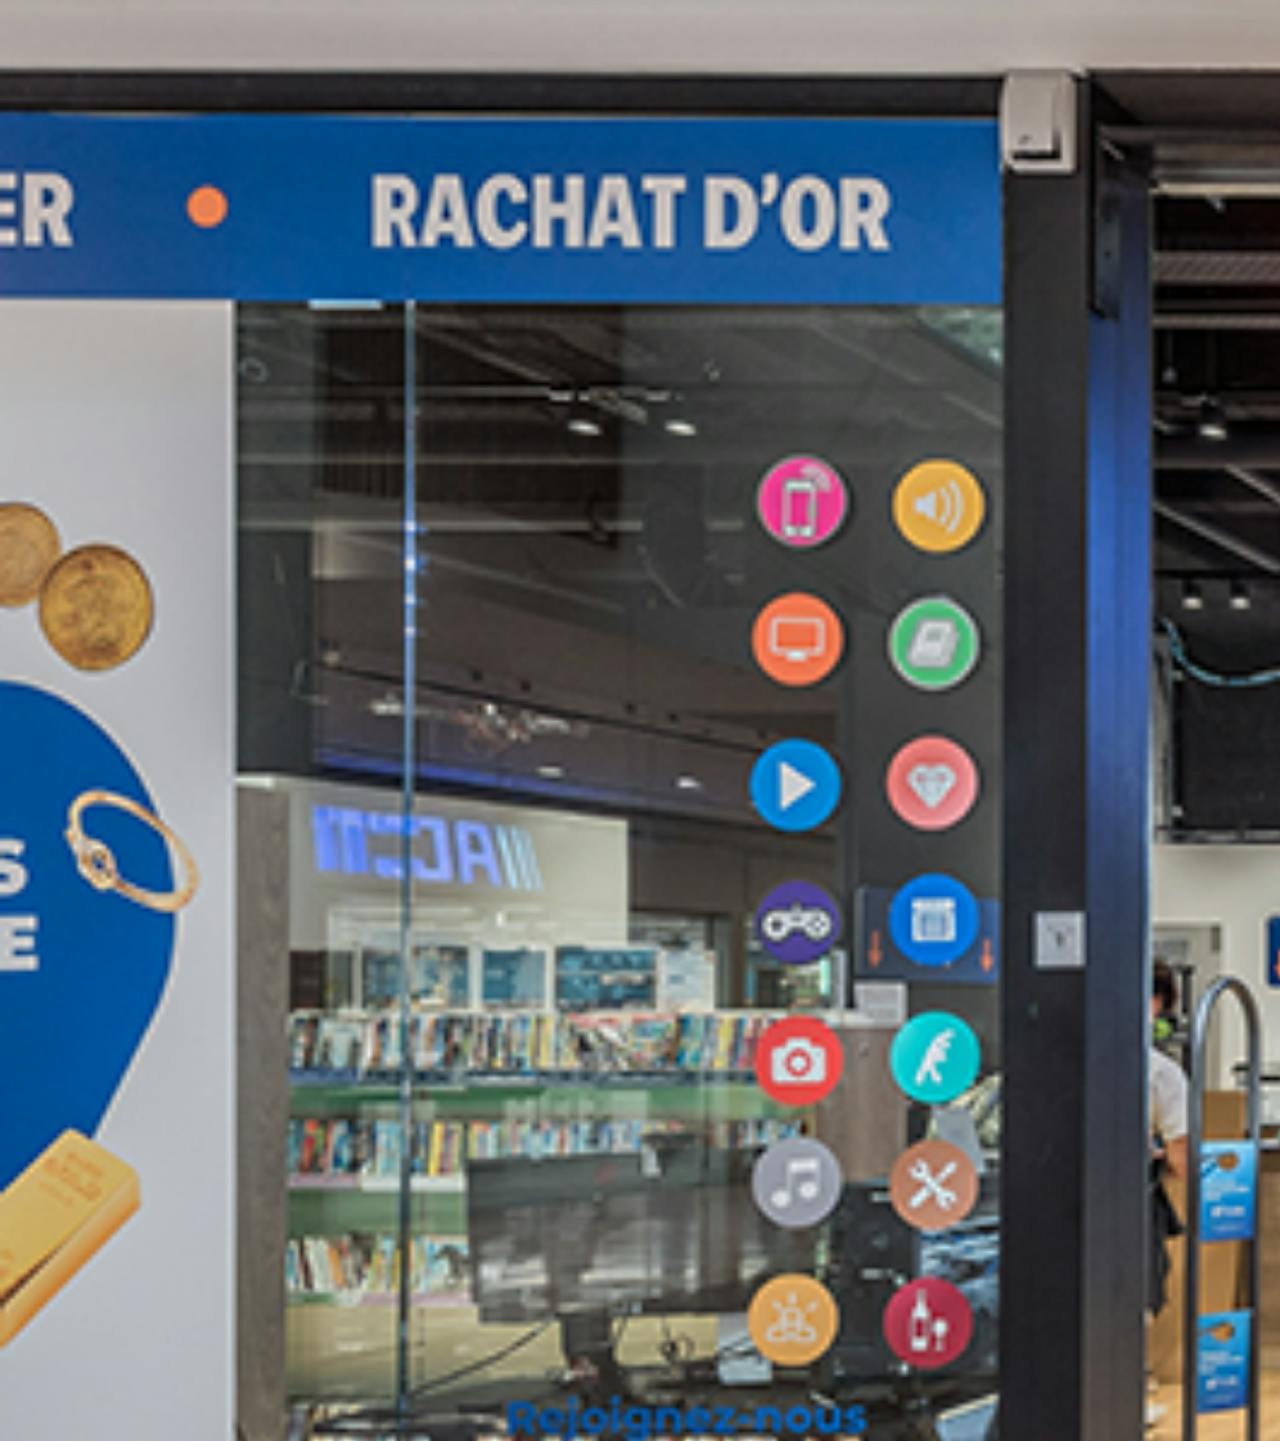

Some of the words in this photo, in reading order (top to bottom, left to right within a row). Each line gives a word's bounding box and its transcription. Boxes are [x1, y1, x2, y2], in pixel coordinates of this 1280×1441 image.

[371, 174, 686, 248] RACHAT
[703, 174, 892, 248] D’OR
[505, 1394, 868, 1441] Rejoignez-nous
